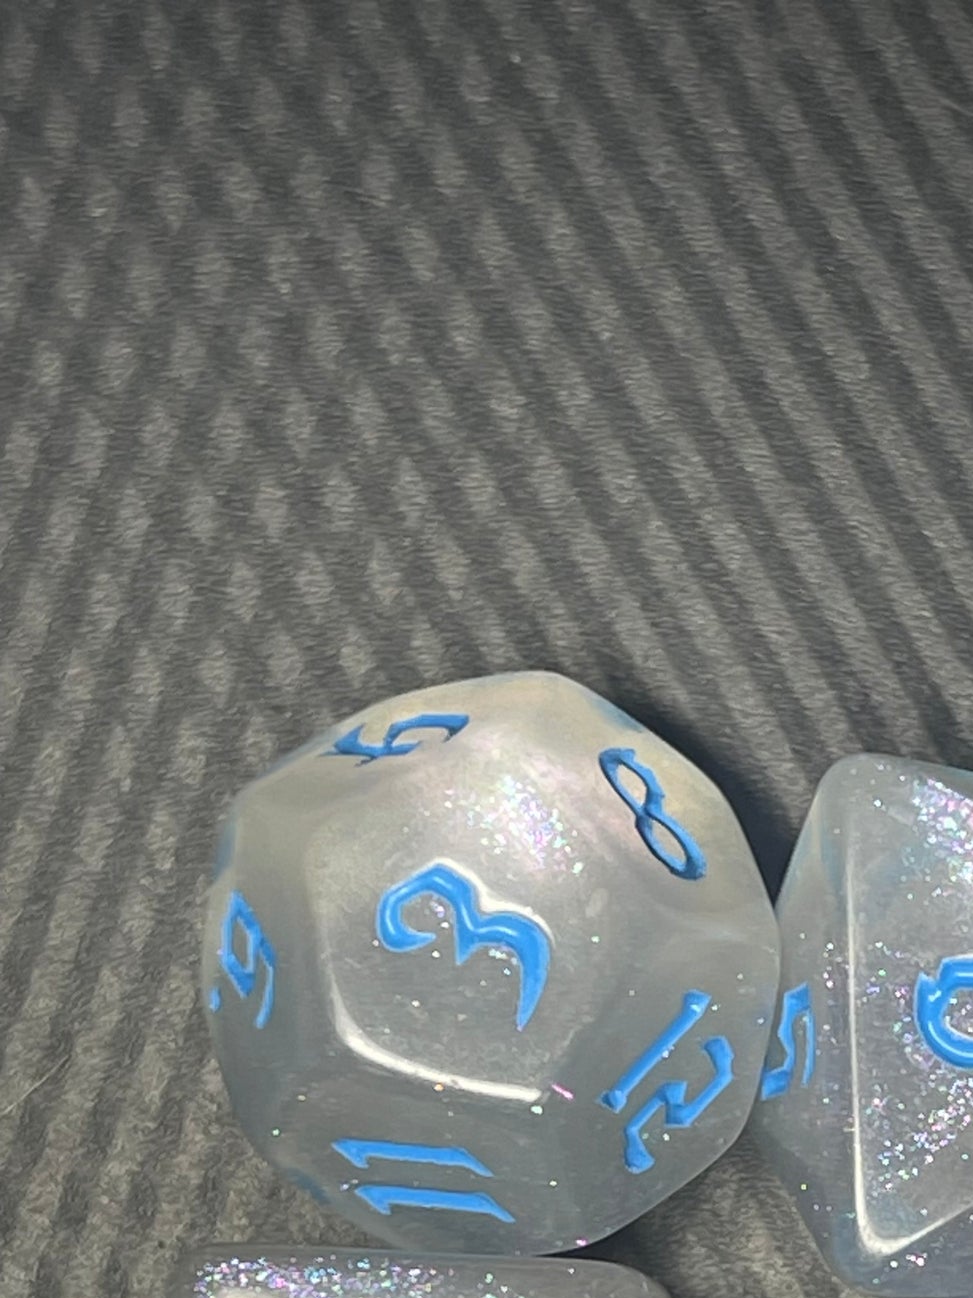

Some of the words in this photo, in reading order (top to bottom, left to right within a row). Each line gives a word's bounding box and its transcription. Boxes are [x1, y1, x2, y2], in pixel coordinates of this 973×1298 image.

[597, 746, 707, 880] 8
[374, 862, 552, 1032] 3
[599, 988, 736, 1174] 12
[330, 1136, 516, 1224] 11
